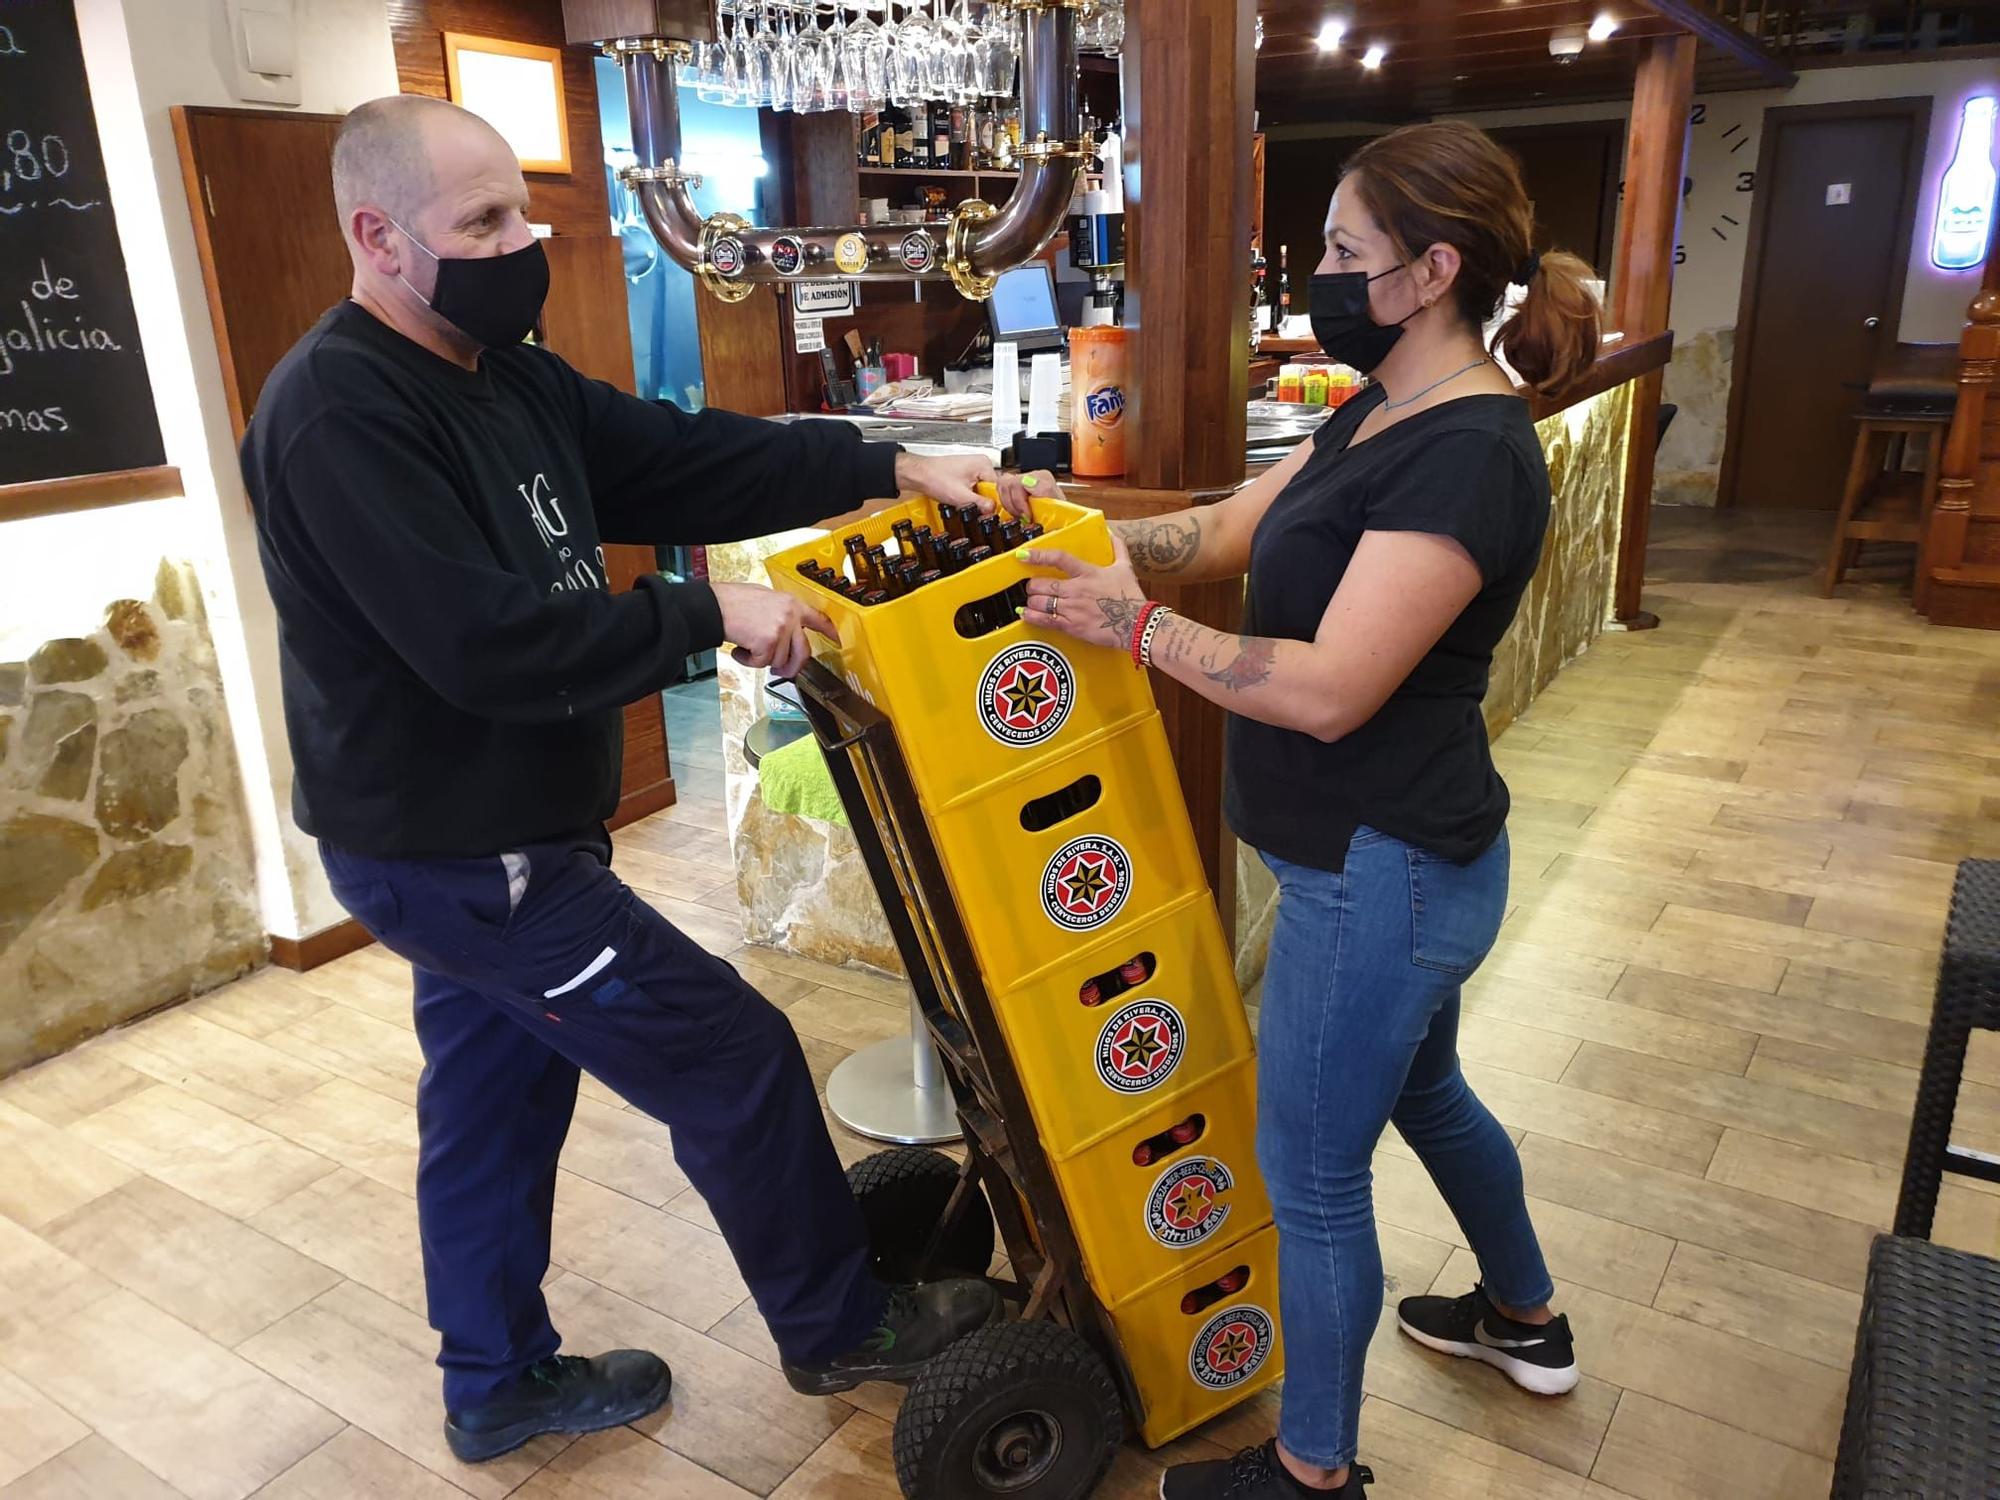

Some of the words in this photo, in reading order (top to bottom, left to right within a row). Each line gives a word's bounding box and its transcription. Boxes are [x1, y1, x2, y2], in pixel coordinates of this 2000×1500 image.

[31, 258, 80, 300] de
[811, 288, 848, 301] ADMISIÓN
[993, 663, 1006, 678] DE
[989, 713, 1040, 739] CERVECEROS
[1041, 706, 1064, 732] DESDE
[1056, 855, 1067, 868] DE
[1051, 901, 1098, 924] CERVECEROS
[1099, 893, 1121, 917] DESDE
[1105, 1066, 1153, 1087] CERVECEROS
